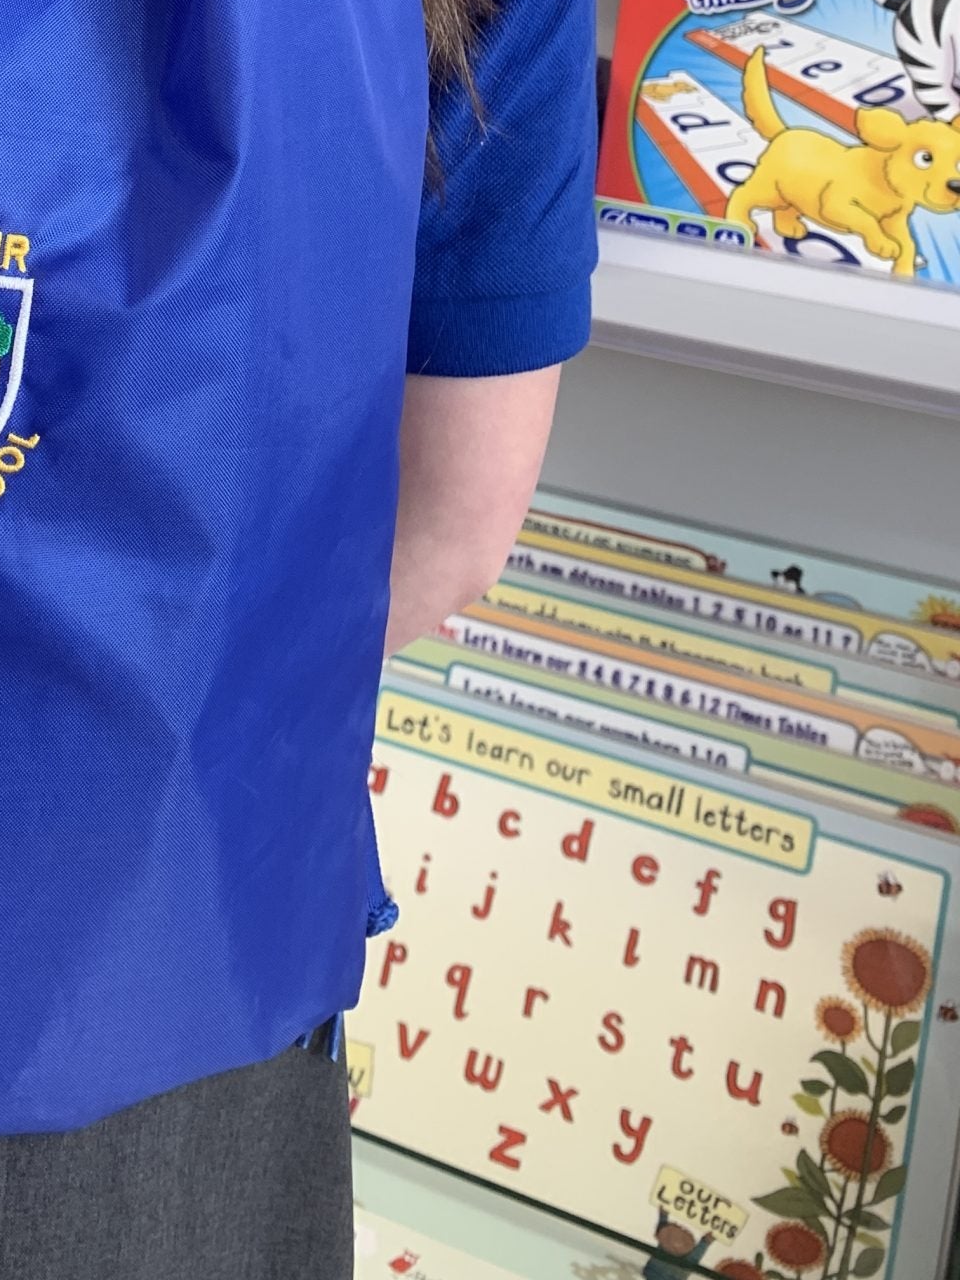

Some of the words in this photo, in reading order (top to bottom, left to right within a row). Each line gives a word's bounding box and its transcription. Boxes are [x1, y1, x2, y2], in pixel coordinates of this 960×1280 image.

[463, 627, 498, 653] Let's
[501, 636, 542, 664] learn
[700, 692, 722, 716] 12
[725, 701, 772, 731] Times
[777, 716, 829, 746] Tables
[387, 708, 452, 744] Let's
[467, 731, 536, 773] learn
[546, 757, 592, 786] our
[608, 777, 685, 818] small
[694, 794, 796, 854] letters
[431, 772, 460, 819] b
[497, 809, 523, 839] c
[561, 819, 595, 863] d
[631, 854, 660, 886] e
[692, 868, 722, 916] f
[764, 896, 799, 950] g
[414, 853, 432, 895] i
[471, 871, 499, 920] j
[547, 901, 574, 948] k
[684, 954, 721, 994] m
[754, 977, 787, 1019] n
[378, 940, 408, 989] p
[445, 963, 472, 1020] q
[522, 985, 550, 1018] r
[668, 1035, 695, 1081] t
[724, 1060, 764, 1107] u
[396, 1021, 430, 1062] v
[463, 1048, 504, 1093] w
[539, 1078, 580, 1123] x
[611, 1108, 653, 1165] y
[488, 1124, 527, 1170] z
[656, 1184, 741, 1241] Letters
